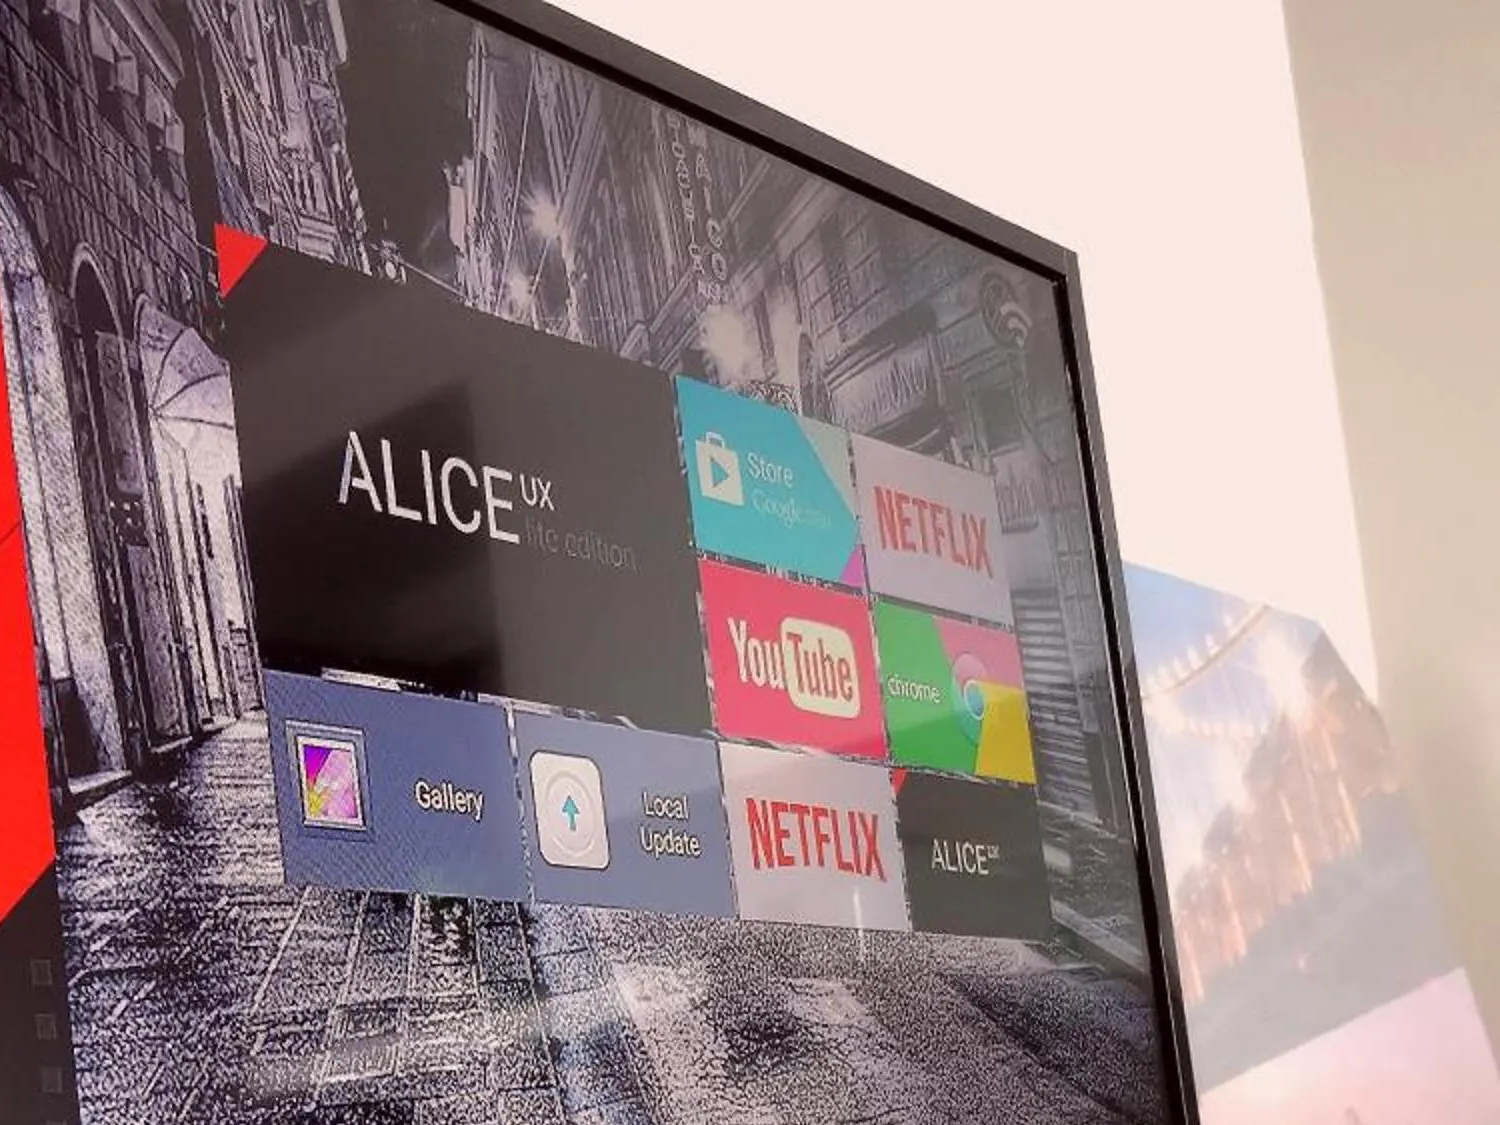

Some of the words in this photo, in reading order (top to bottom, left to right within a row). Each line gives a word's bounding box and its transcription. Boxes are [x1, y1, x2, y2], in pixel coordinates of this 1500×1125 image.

[337, 431, 520, 544] ALICE
[519, 473, 555, 511] UX
[747, 452, 793, 487] Store
[874, 485, 994, 579] NETFLIX
[414, 780, 484, 821] Gallery
[642, 791, 690, 820] Local
[640, 826, 702, 860] Update
[745, 797, 888, 883] NETFLIX
[931, 838, 989, 875] ALICE
